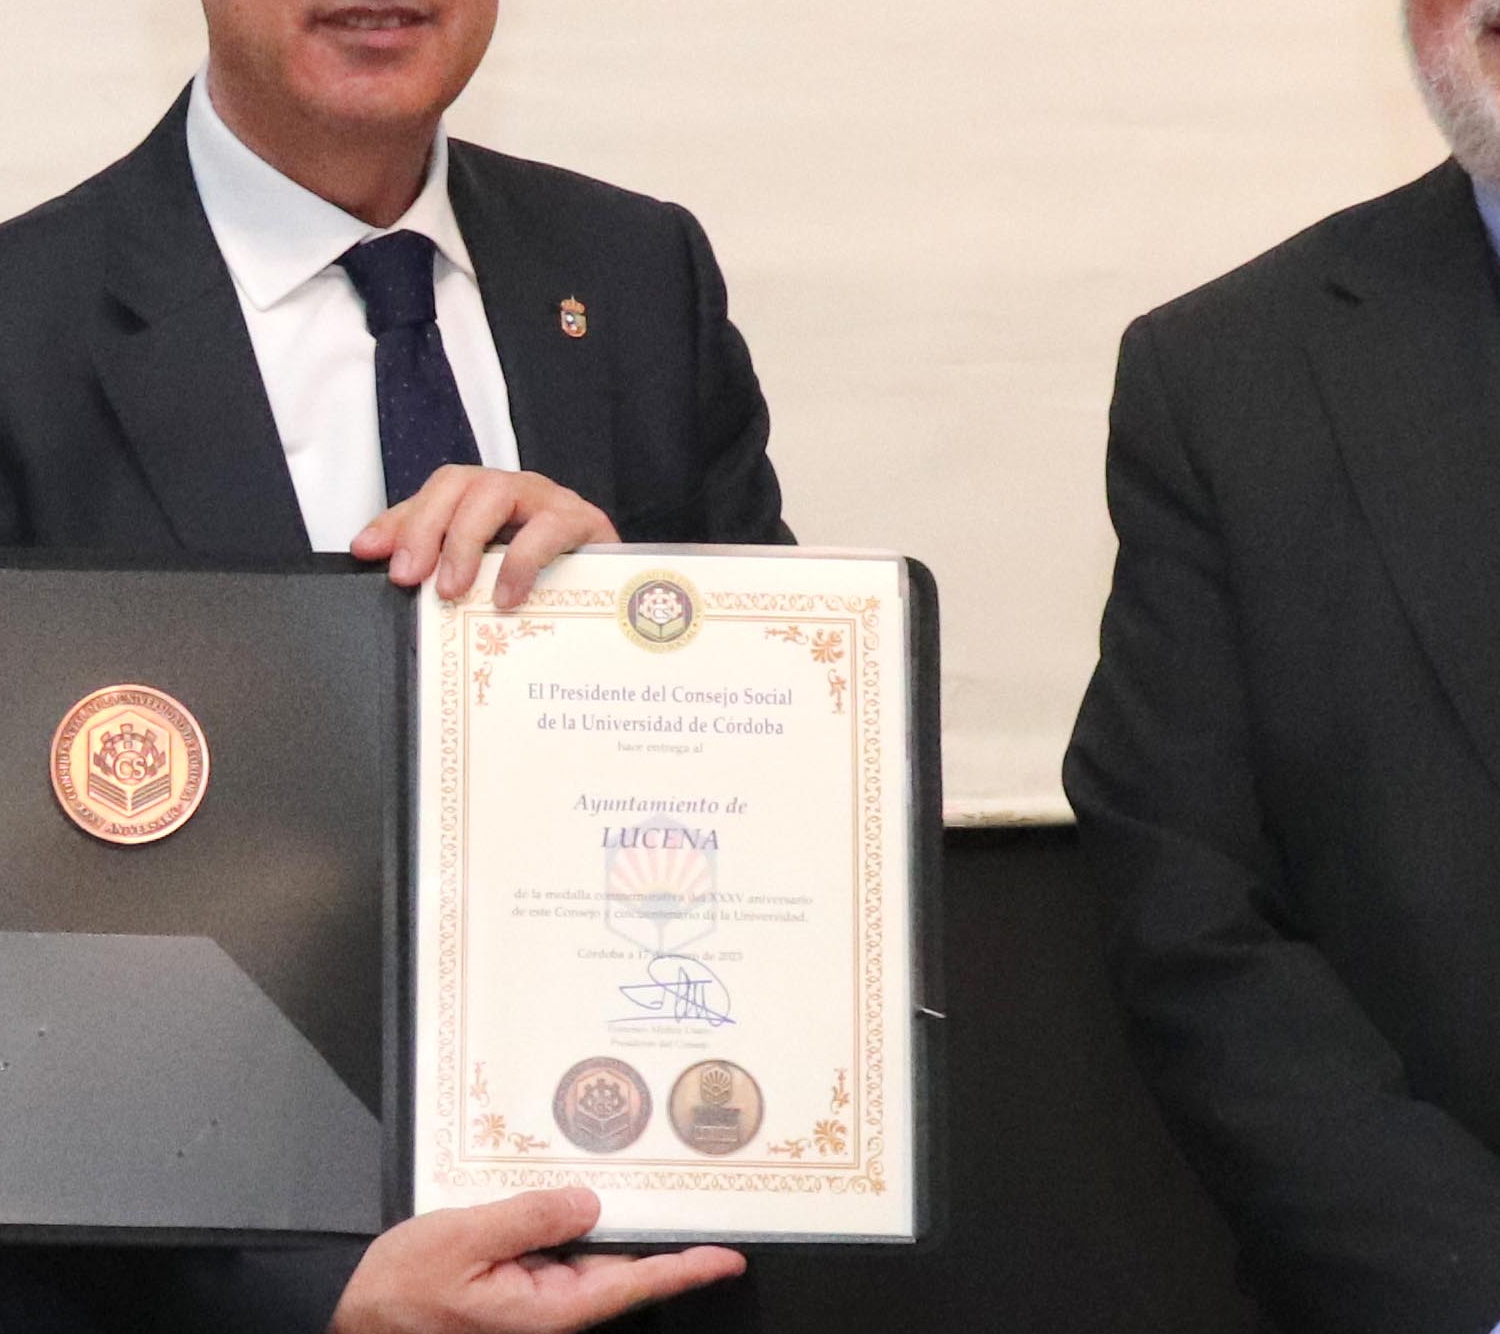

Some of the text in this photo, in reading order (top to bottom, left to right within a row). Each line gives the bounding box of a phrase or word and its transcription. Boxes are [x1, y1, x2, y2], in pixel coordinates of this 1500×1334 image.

[527, 683, 793, 709] El Presidente del Consejo Social
[537, 713, 784, 735] de la Universidad de Córdoba
[617, 741, 643, 753] hace
[115, 756, 147, 779] CS
[573, 794, 749, 817] Ayuntamiento de
[600, 825, 721, 851] LUCENA
